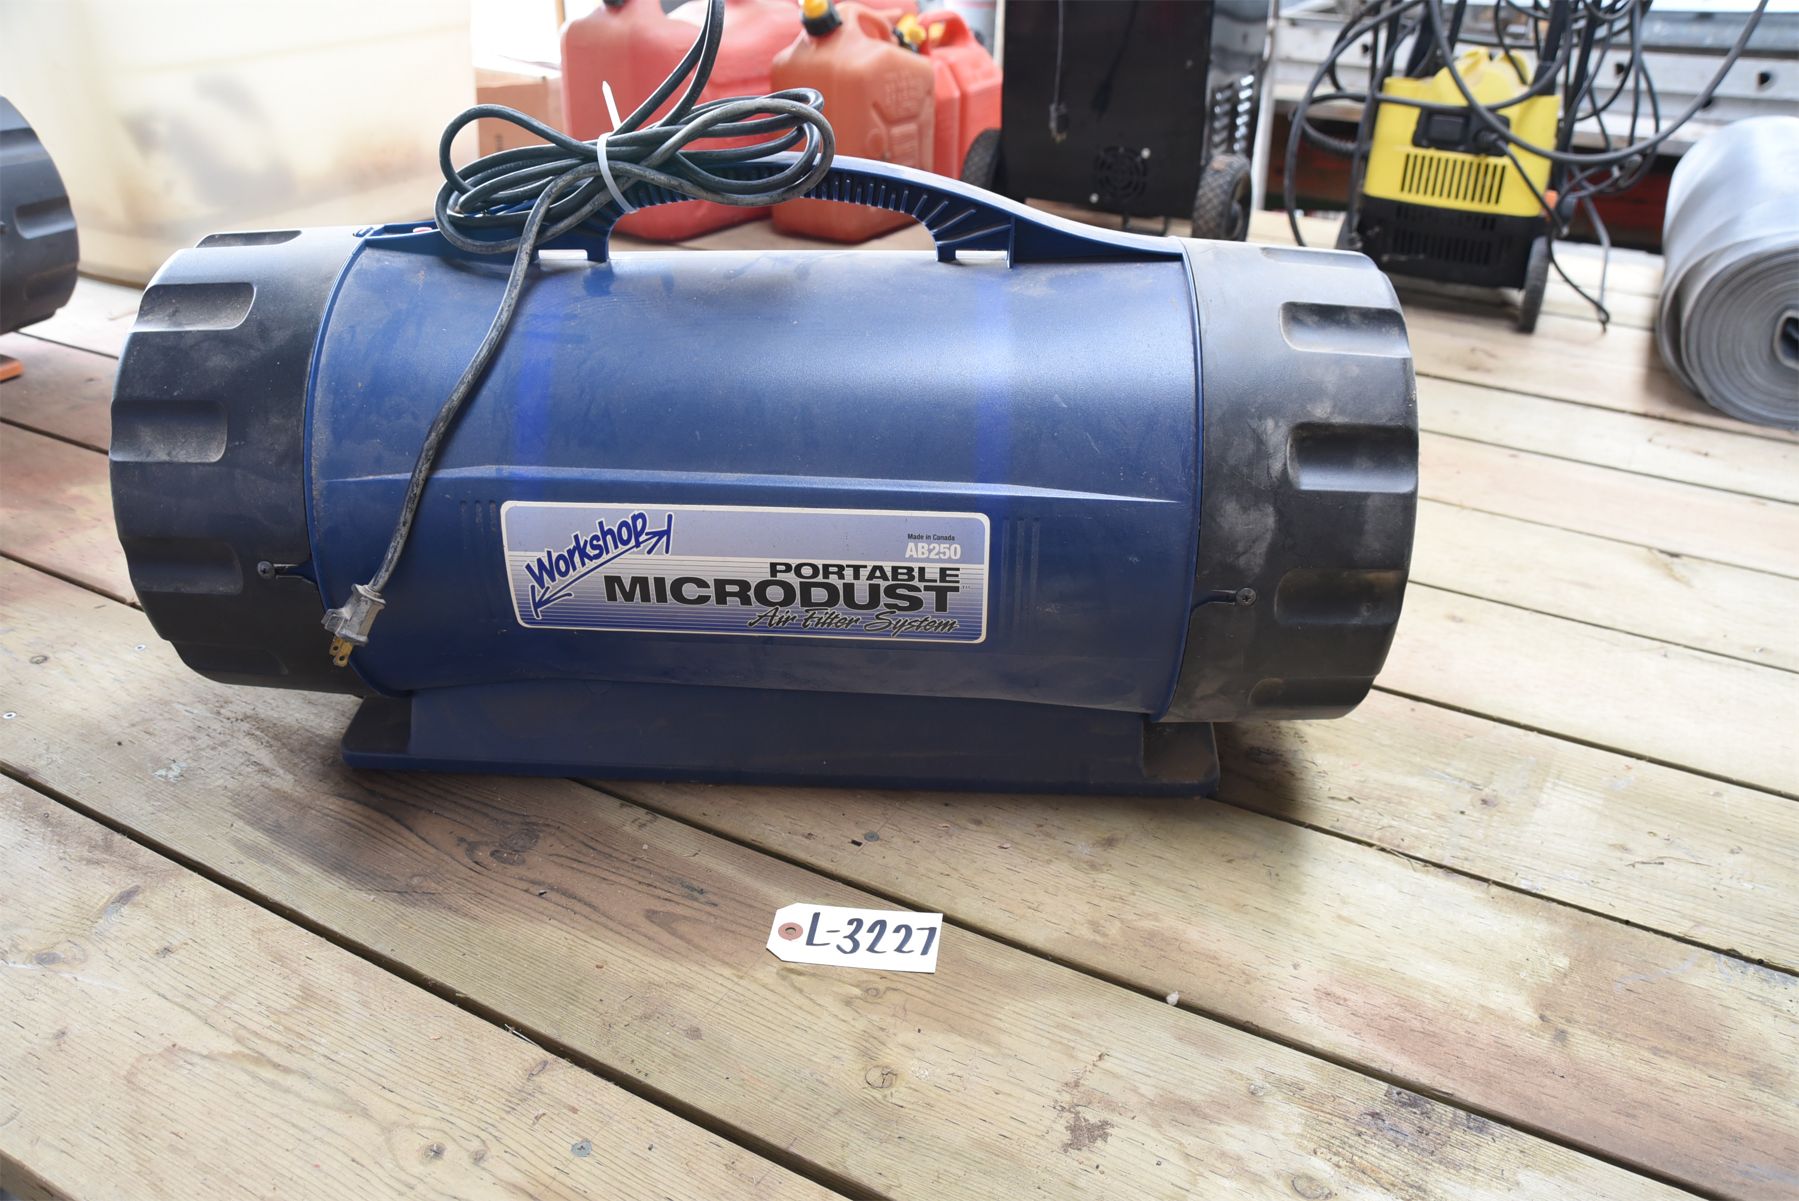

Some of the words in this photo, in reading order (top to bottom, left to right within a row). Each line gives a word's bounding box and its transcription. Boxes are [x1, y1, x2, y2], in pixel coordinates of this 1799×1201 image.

[524, 510, 648, 590] Workshop
[904, 542, 962, 560] AB250
[769, 561, 961, 584] PORTABLE
[603, 574, 960, 613] MICRODUST
[748, 606, 798, 628] Air
[801, 607, 861, 632] Filter
[863, 610, 961, 637] System
[805, 911, 938, 955] L-3227
